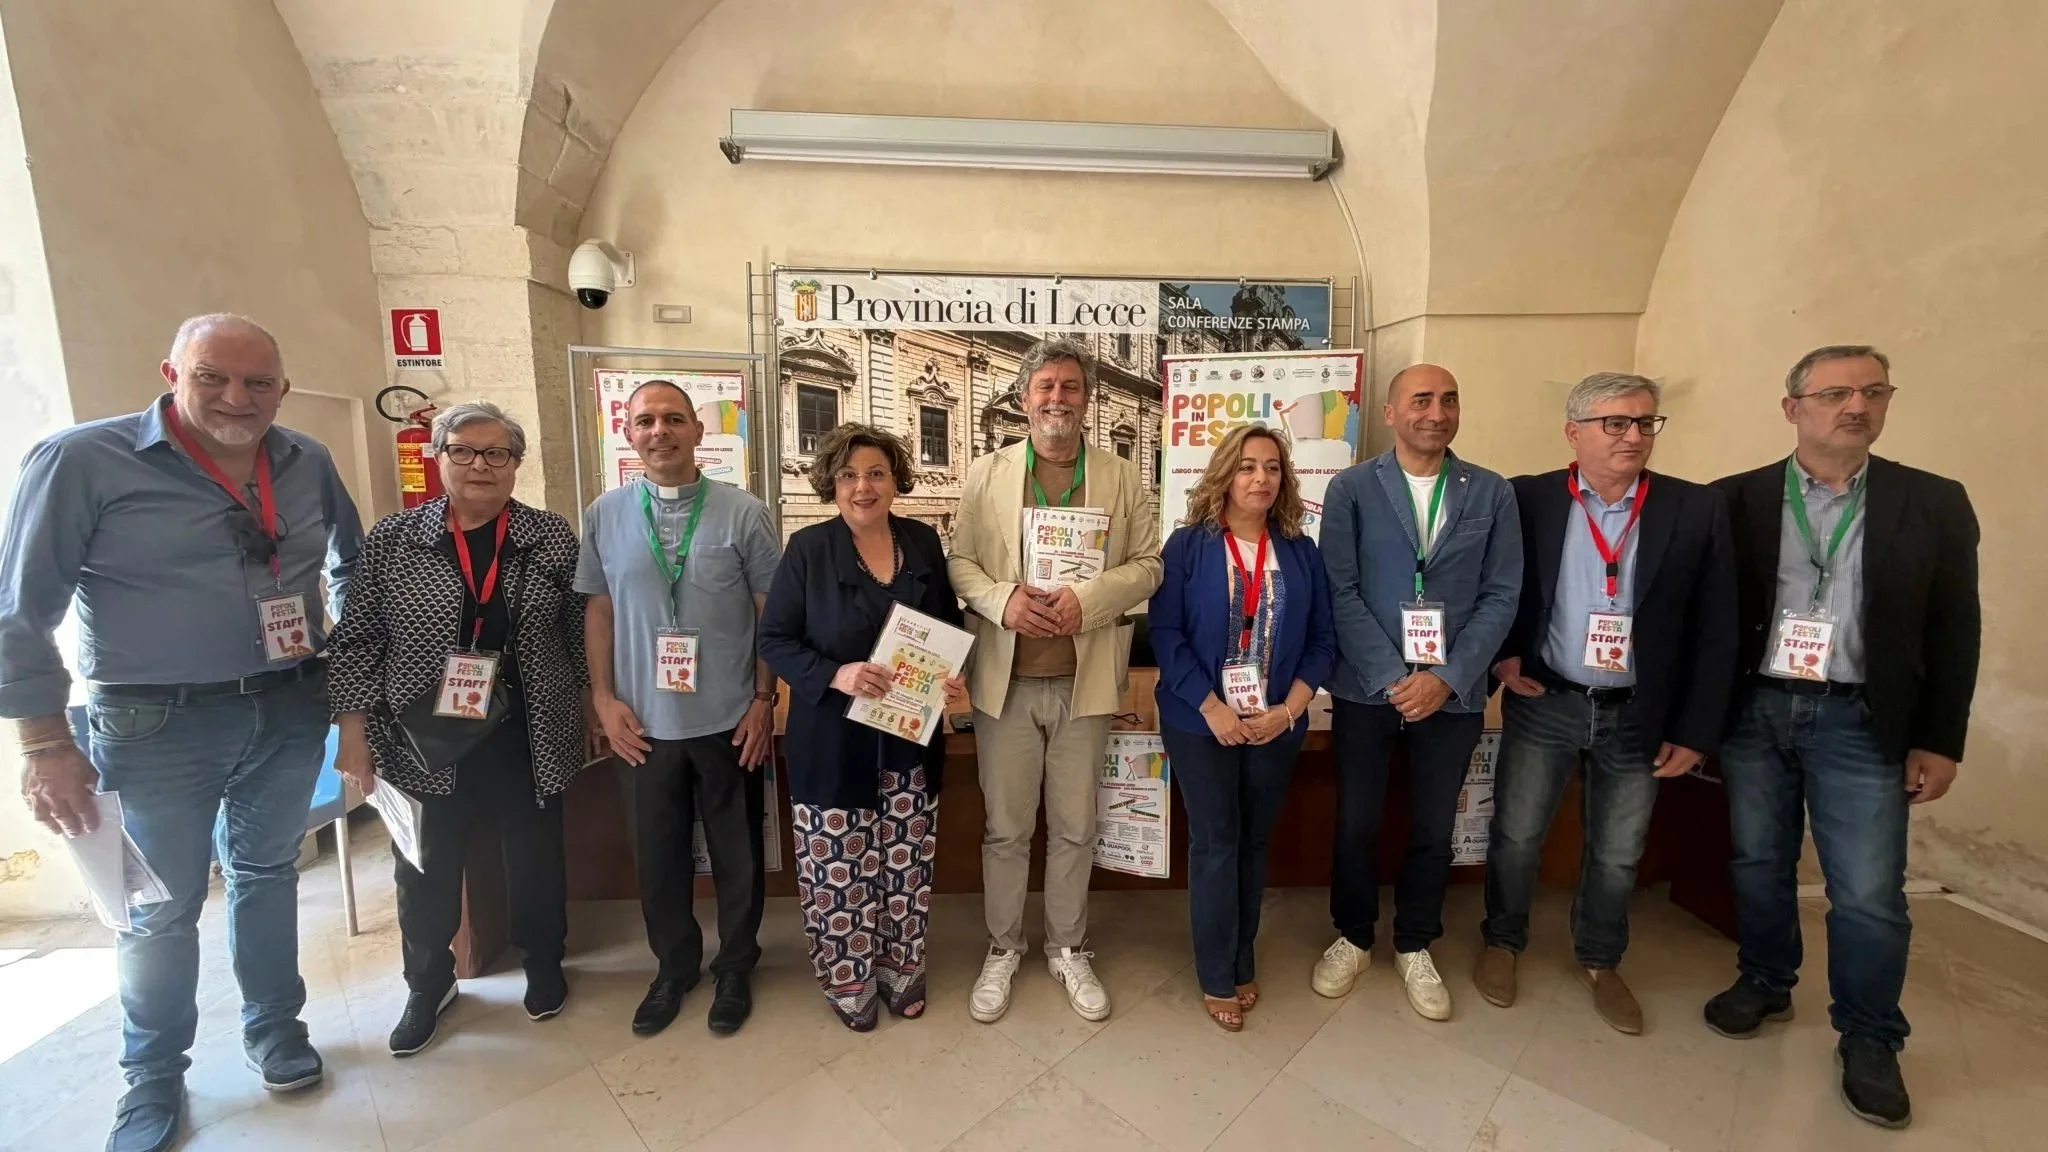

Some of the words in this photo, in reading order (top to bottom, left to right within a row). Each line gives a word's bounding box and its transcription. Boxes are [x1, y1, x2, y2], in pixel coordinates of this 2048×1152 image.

[831, 284, 993, 324] Provincia
[1005, 287, 1038, 325] di
[1046, 289, 1147, 328] Lecce
[1168, 296, 1201, 310] SALA
[1168, 314, 1255, 330] CONFERENZE
[1257, 316, 1311, 331] STAMPA
[397, 358, 442, 367] ESTINTORE
[1172, 393, 1271, 419] POPOLI
[1191, 412, 1204, 422] IN
[1038, 524, 1073, 537] POPOLI
[1037, 535, 1072, 547] FESTA
[267, 616, 304, 631] STAFF
[1407, 629, 1438, 638] STAFF
[1590, 633, 1627, 644] STAFF
[1783, 638, 1825, 651] STAFF
[660, 656, 692, 665] STAFF
[897, 661, 936, 684] POPOLI
[448, 677, 487, 688] STAFF
[892, 672, 930, 695] FESTA
[1228, 684, 1257, 694] STAFF
